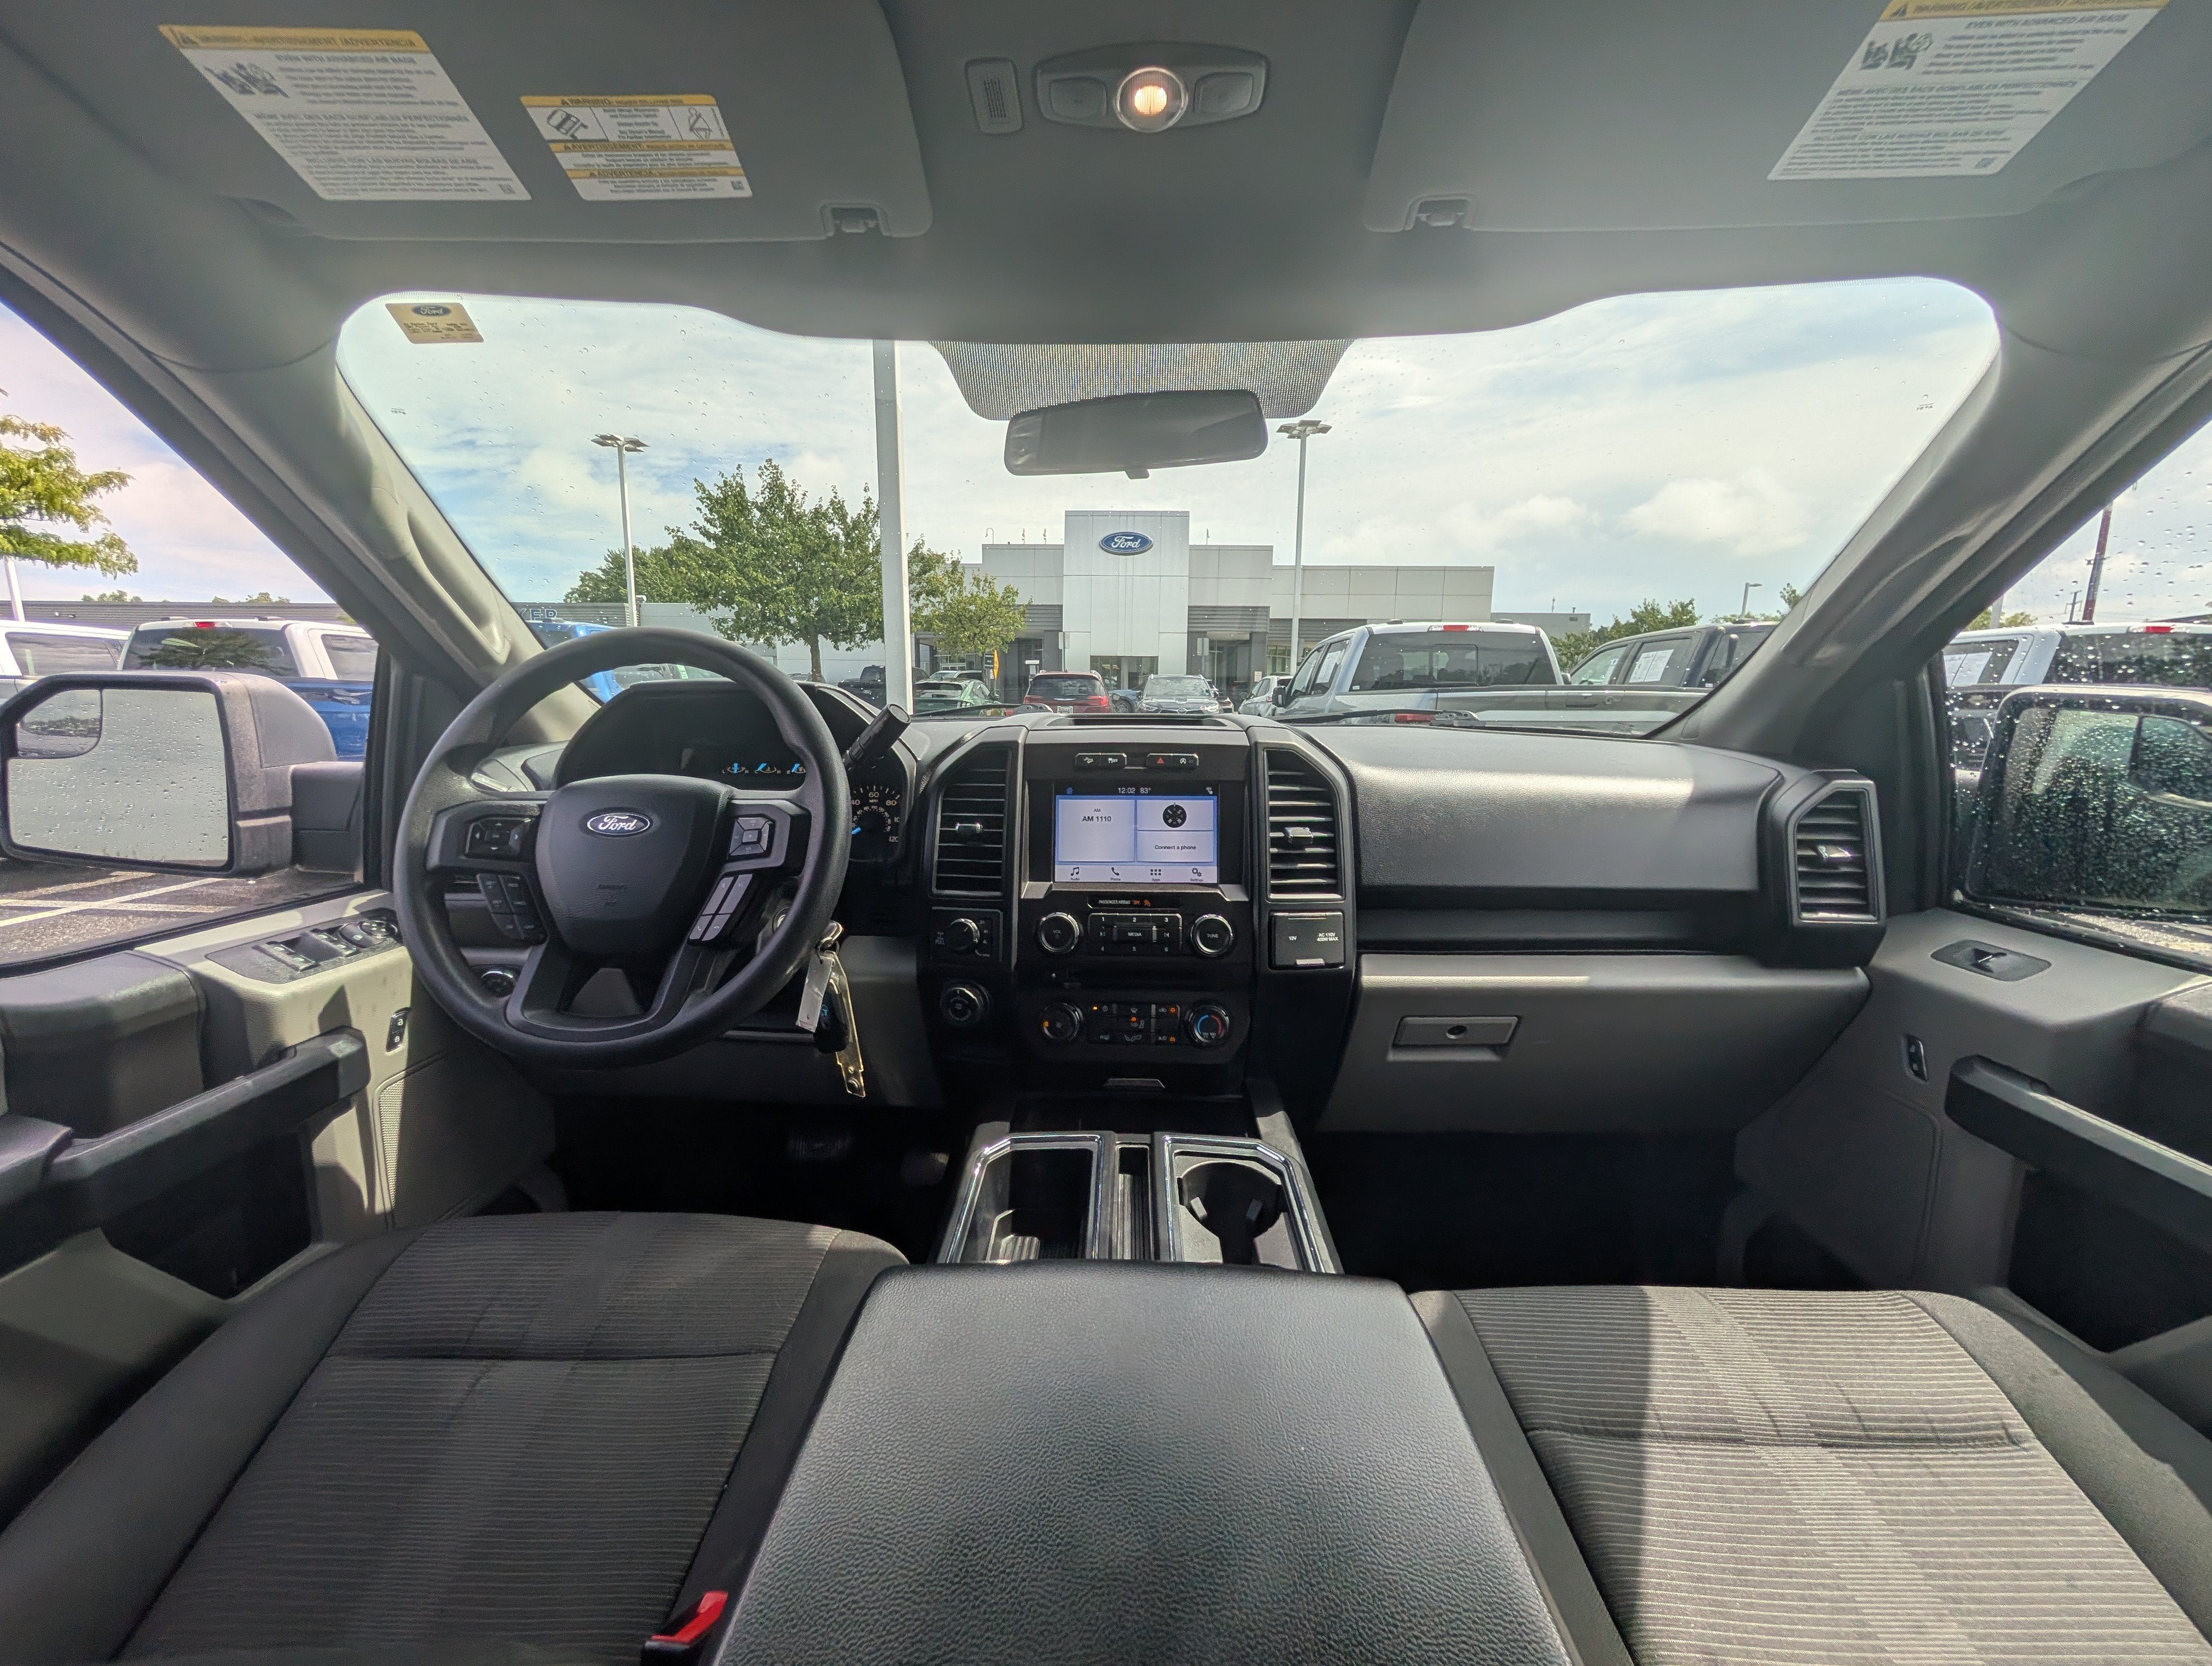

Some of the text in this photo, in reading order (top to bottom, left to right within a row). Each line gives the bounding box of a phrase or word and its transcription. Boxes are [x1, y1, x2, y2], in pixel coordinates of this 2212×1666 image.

[420, 306, 443, 315] Ford
[1111, 536, 1142, 548] Ford
[597, 815, 638, 831] Ford
